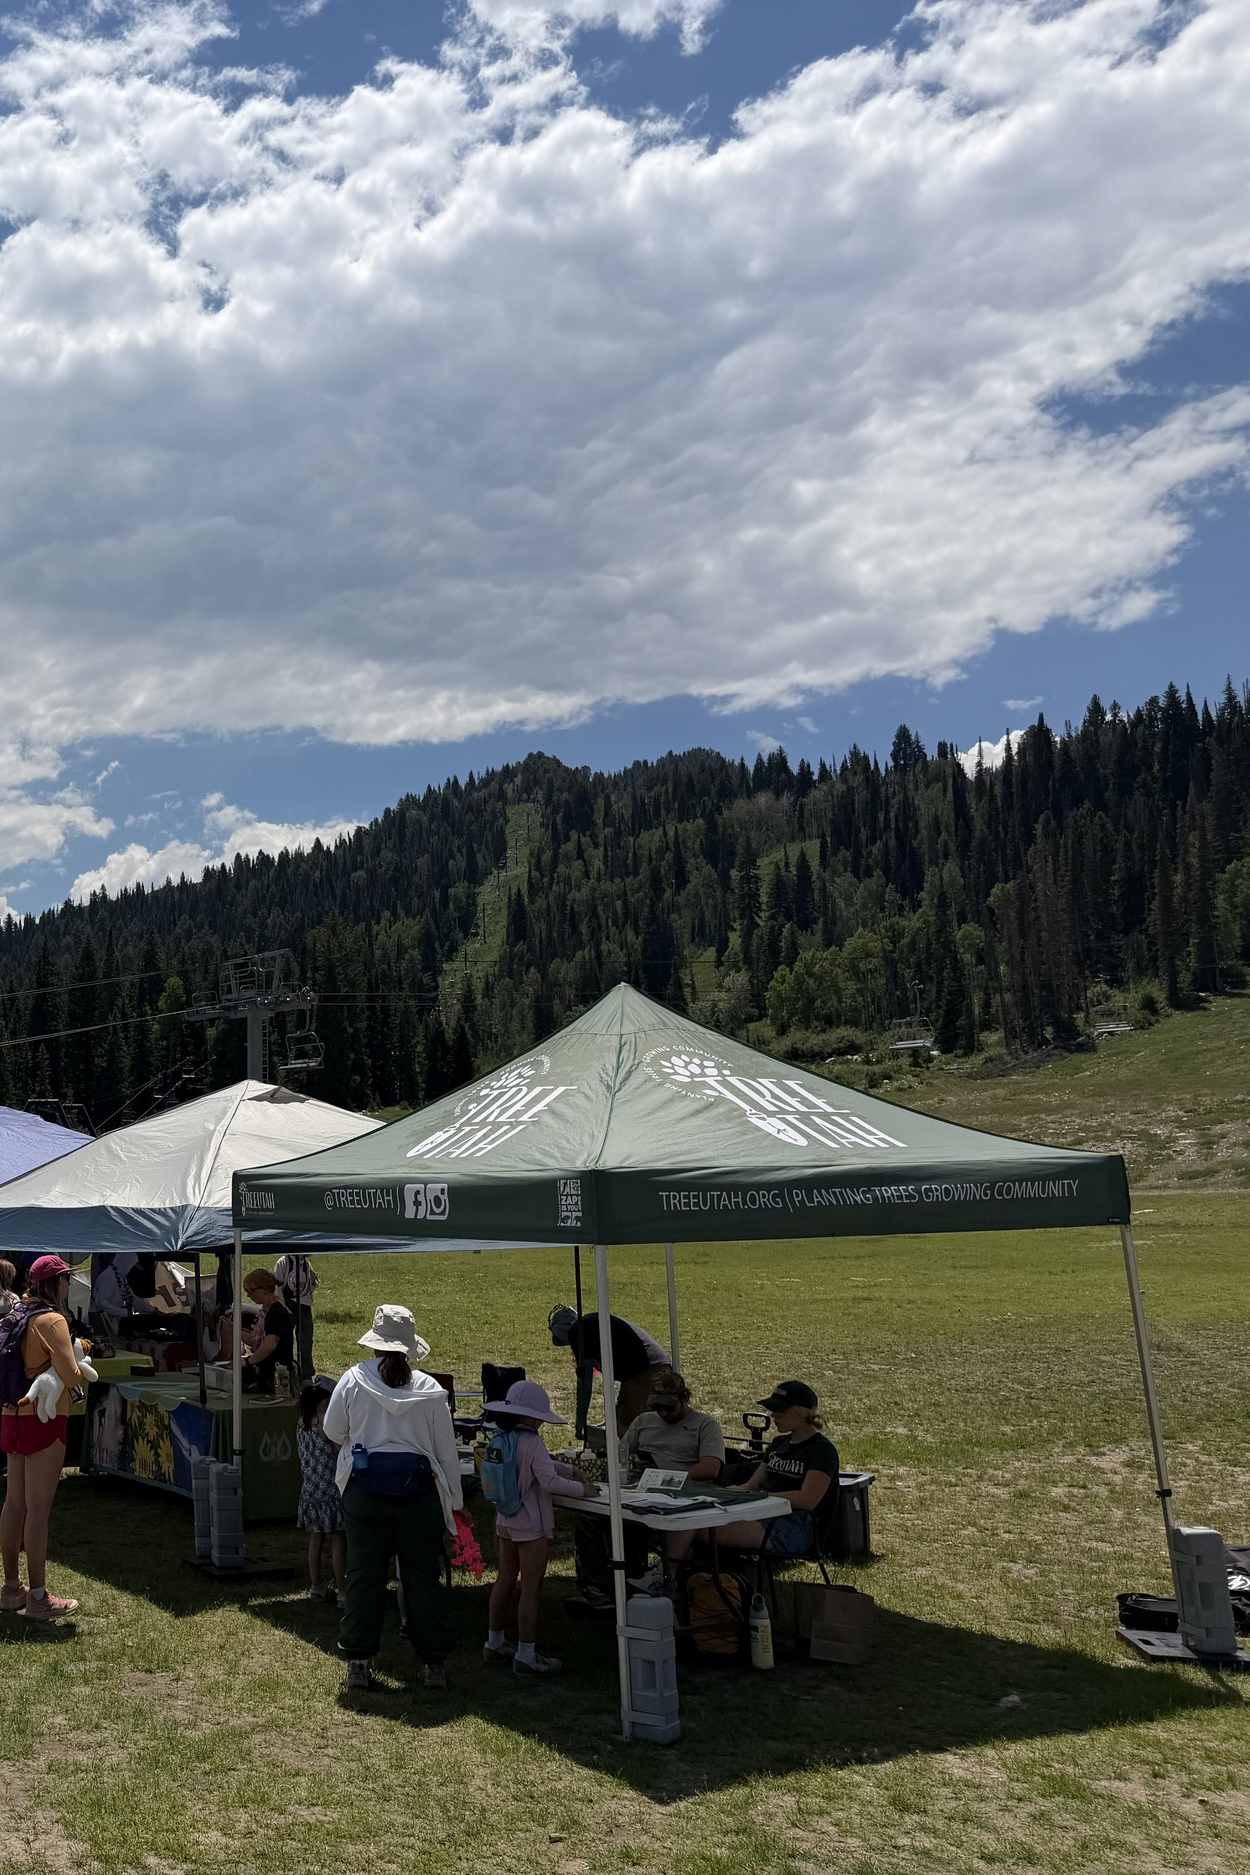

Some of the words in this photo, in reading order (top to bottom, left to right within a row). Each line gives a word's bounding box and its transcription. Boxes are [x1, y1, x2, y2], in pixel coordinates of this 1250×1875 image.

[673, 1045, 734, 1067] COMMUNITY
[457, 1086, 578, 1123] TREE
[693, 1076, 851, 1113] TREE
[241, 1191, 275, 1209] TREEUTAH
[323, 1188, 394, 1211] @TREEUTAH
[560, 1195, 578, 1205] ZAP
[658, 1189, 783, 1211] TREEUTAH.ORG
[792, 1186, 873, 1207] PLANTING
[870, 1185, 920, 1204] TREES
[921, 1182, 991, 1203] GROWING
[993, 1179, 1079, 1200] COMMUNITY
